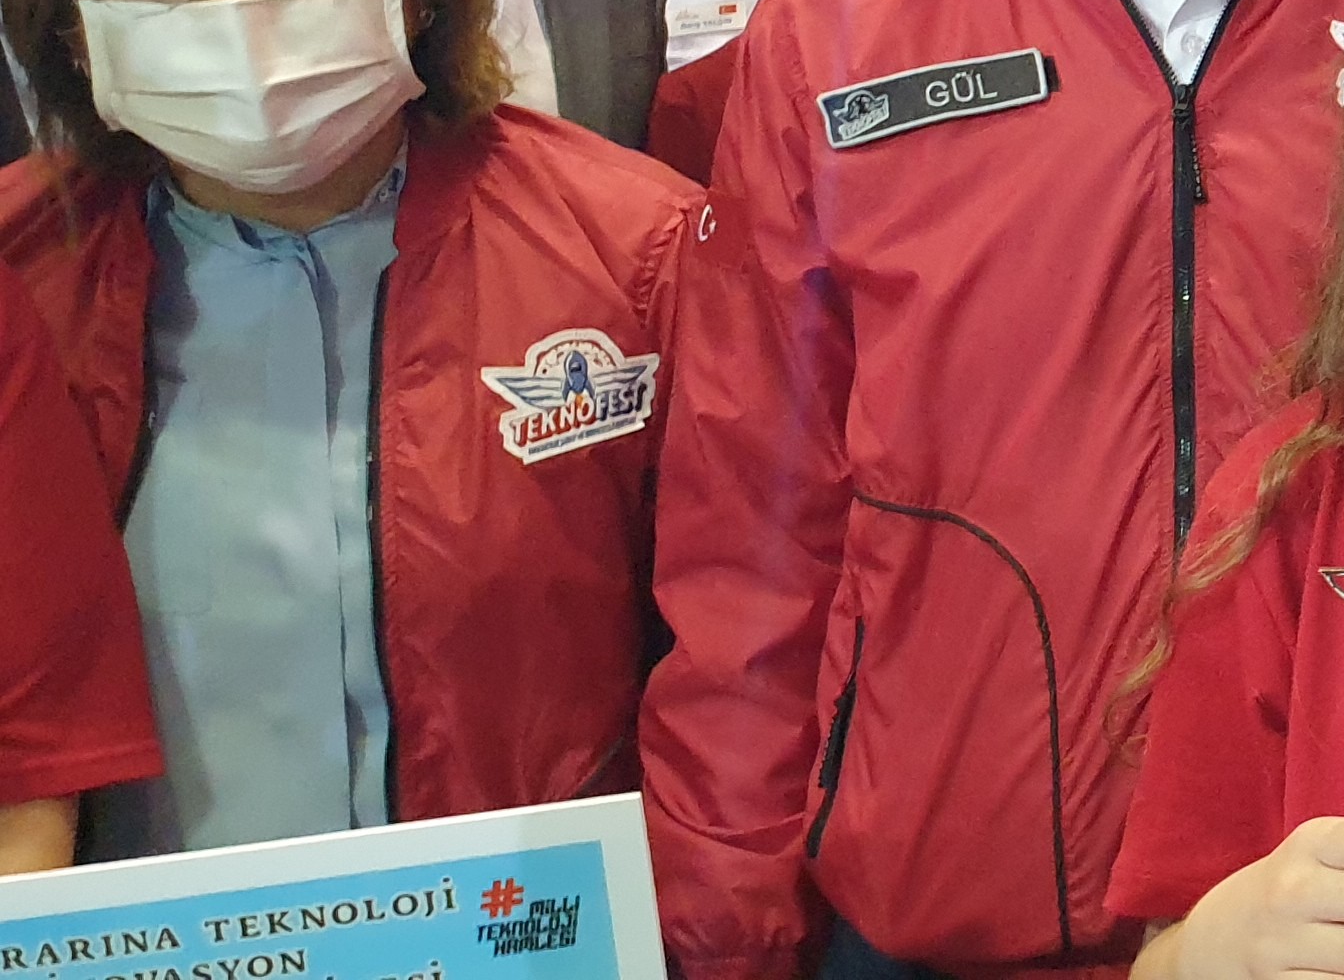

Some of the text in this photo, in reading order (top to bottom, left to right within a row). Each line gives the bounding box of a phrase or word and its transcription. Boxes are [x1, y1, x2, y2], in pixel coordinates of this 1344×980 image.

[925, 70, 998, 107] GÜL
[512, 382, 648, 447] TEKNOFEST
[1, 877, 457, 971] RARINA TEKNOLOJİ
